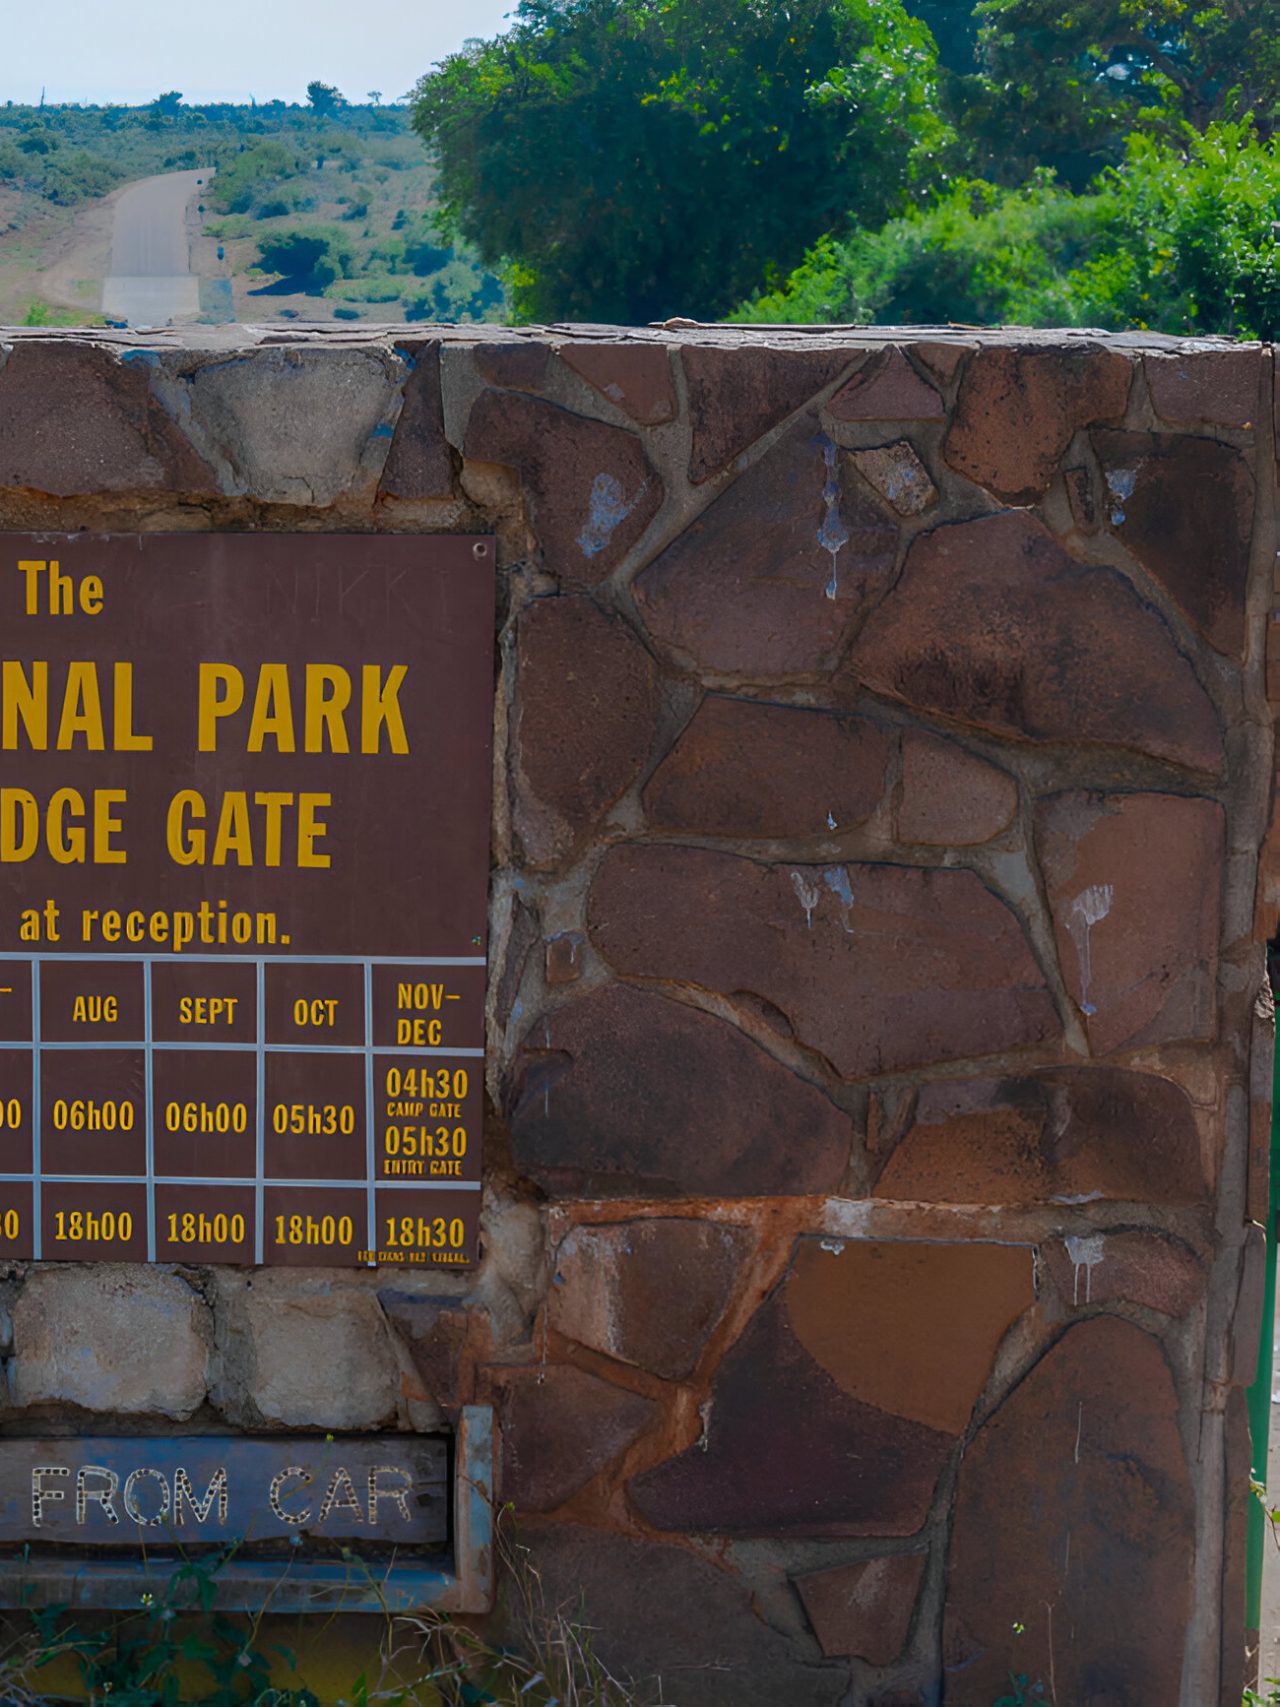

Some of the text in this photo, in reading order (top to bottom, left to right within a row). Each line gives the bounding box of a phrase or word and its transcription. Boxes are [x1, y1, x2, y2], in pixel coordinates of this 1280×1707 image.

[18, 560, 103, 615] The
[198, 663, 409, 754] PARK
[167, 789, 331, 868] GATE
[20, 900, 60, 941] at
[83, 900, 290, 950] reception.
[73, 996, 117, 1022] AUG
[180, 997, 238, 1024] SEPT
[294, 999, 339, 1026] OCT
[397, 1019, 441, 1045] DEC
[386, 1068, 468, 1099] 04h30
[54, 1100, 134, 1130] 06h00
[166, 1102, 247, 1133] 06h00
[273, 1104, 354, 1134] 05h30
[387, 1102, 423, 1117] CAMP
[385, 1126, 466, 1157] 05h30
[55, 1212, 132, 1241] 18h00
[168, 1213, 244, 1243] 18h00
[275, 1215, 352, 1245] 18h00
[386, 1217, 464, 1248] 18h30
[32, 1466, 228, 1527] FROM
[269, 1465, 413, 1525] CAR
